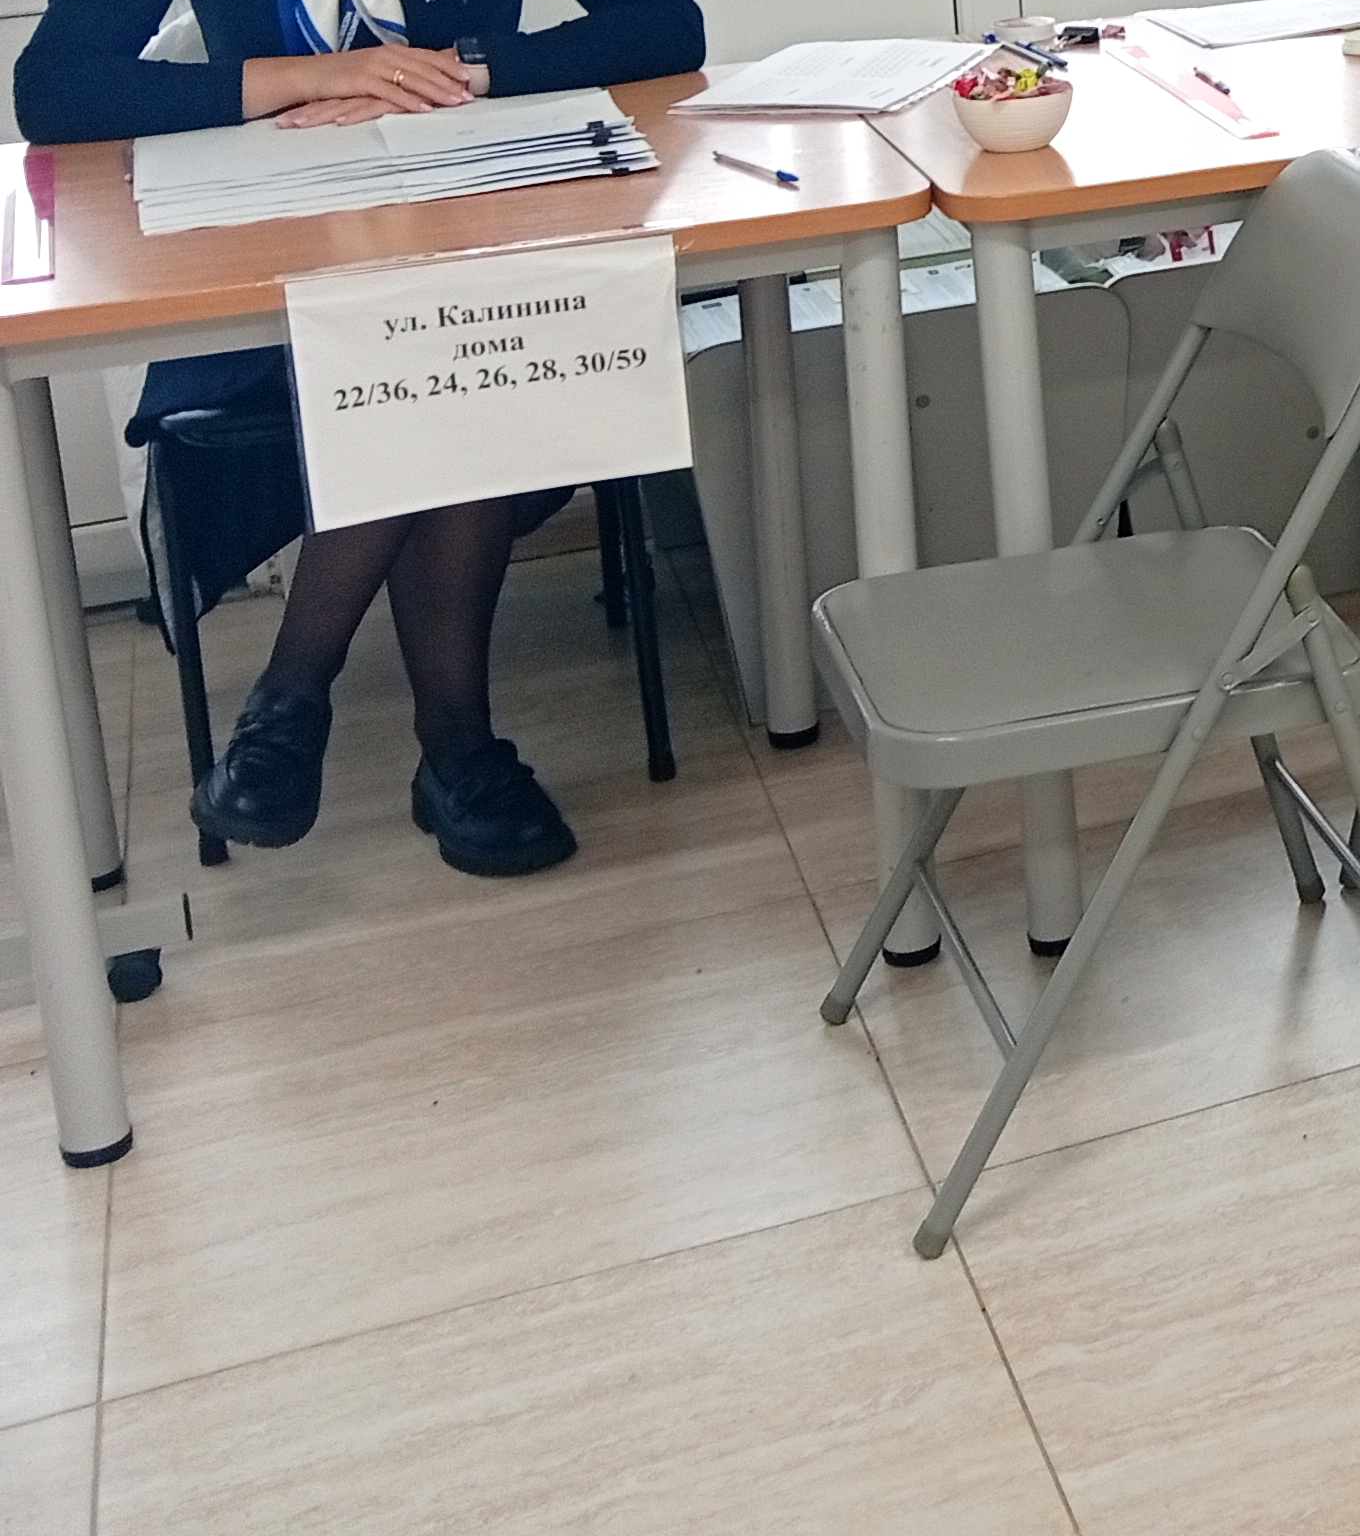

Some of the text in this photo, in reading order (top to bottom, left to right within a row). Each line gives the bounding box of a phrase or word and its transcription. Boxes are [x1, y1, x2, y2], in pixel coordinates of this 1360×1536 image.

[384, 294, 587, 340] ул. Калинина
[453, 335, 525, 361] дома
[335, 347, 647, 411] 22/36, 24, 26, 28, 30/59
